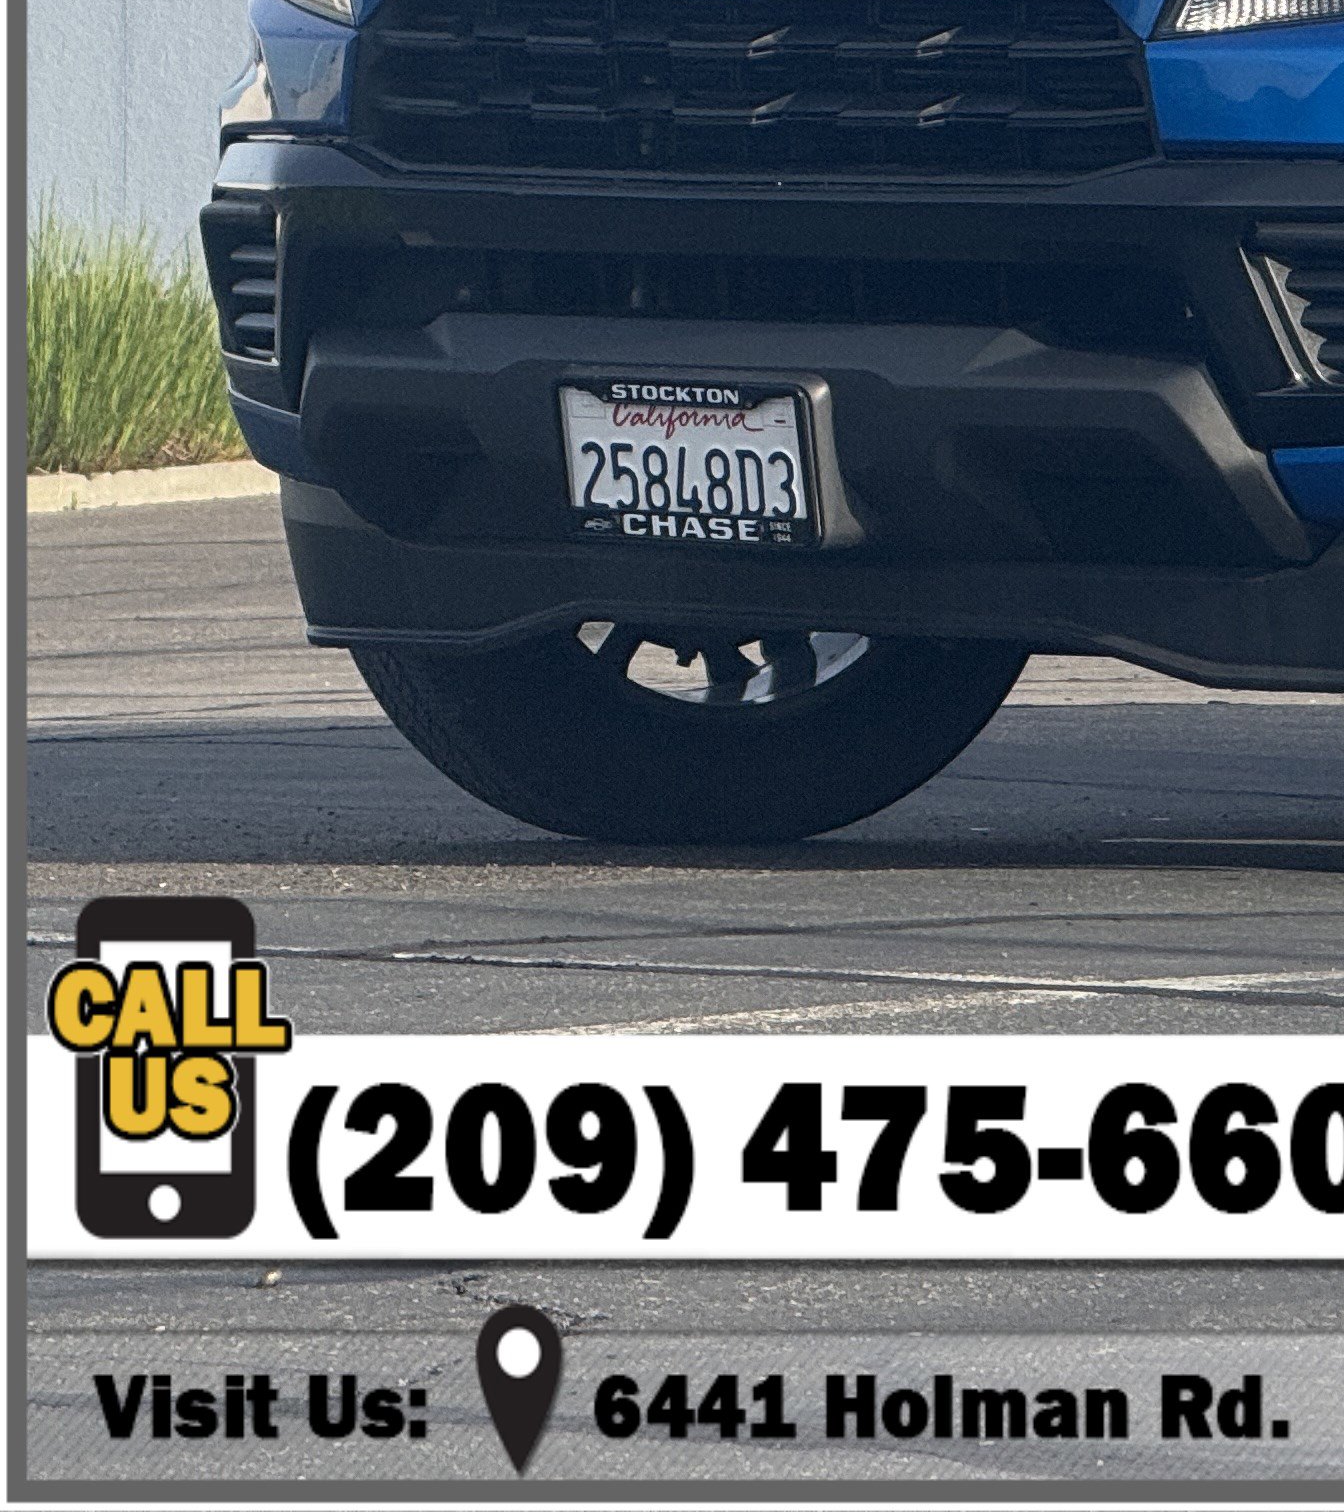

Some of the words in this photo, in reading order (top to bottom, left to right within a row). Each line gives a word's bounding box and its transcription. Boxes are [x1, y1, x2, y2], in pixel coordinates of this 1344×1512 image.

[611, 383, 740, 406] STOCKTON
[612, 404, 764, 440] California
[581, 440, 798, 520] 25848D3
[622, 512, 761, 542] CHASE
